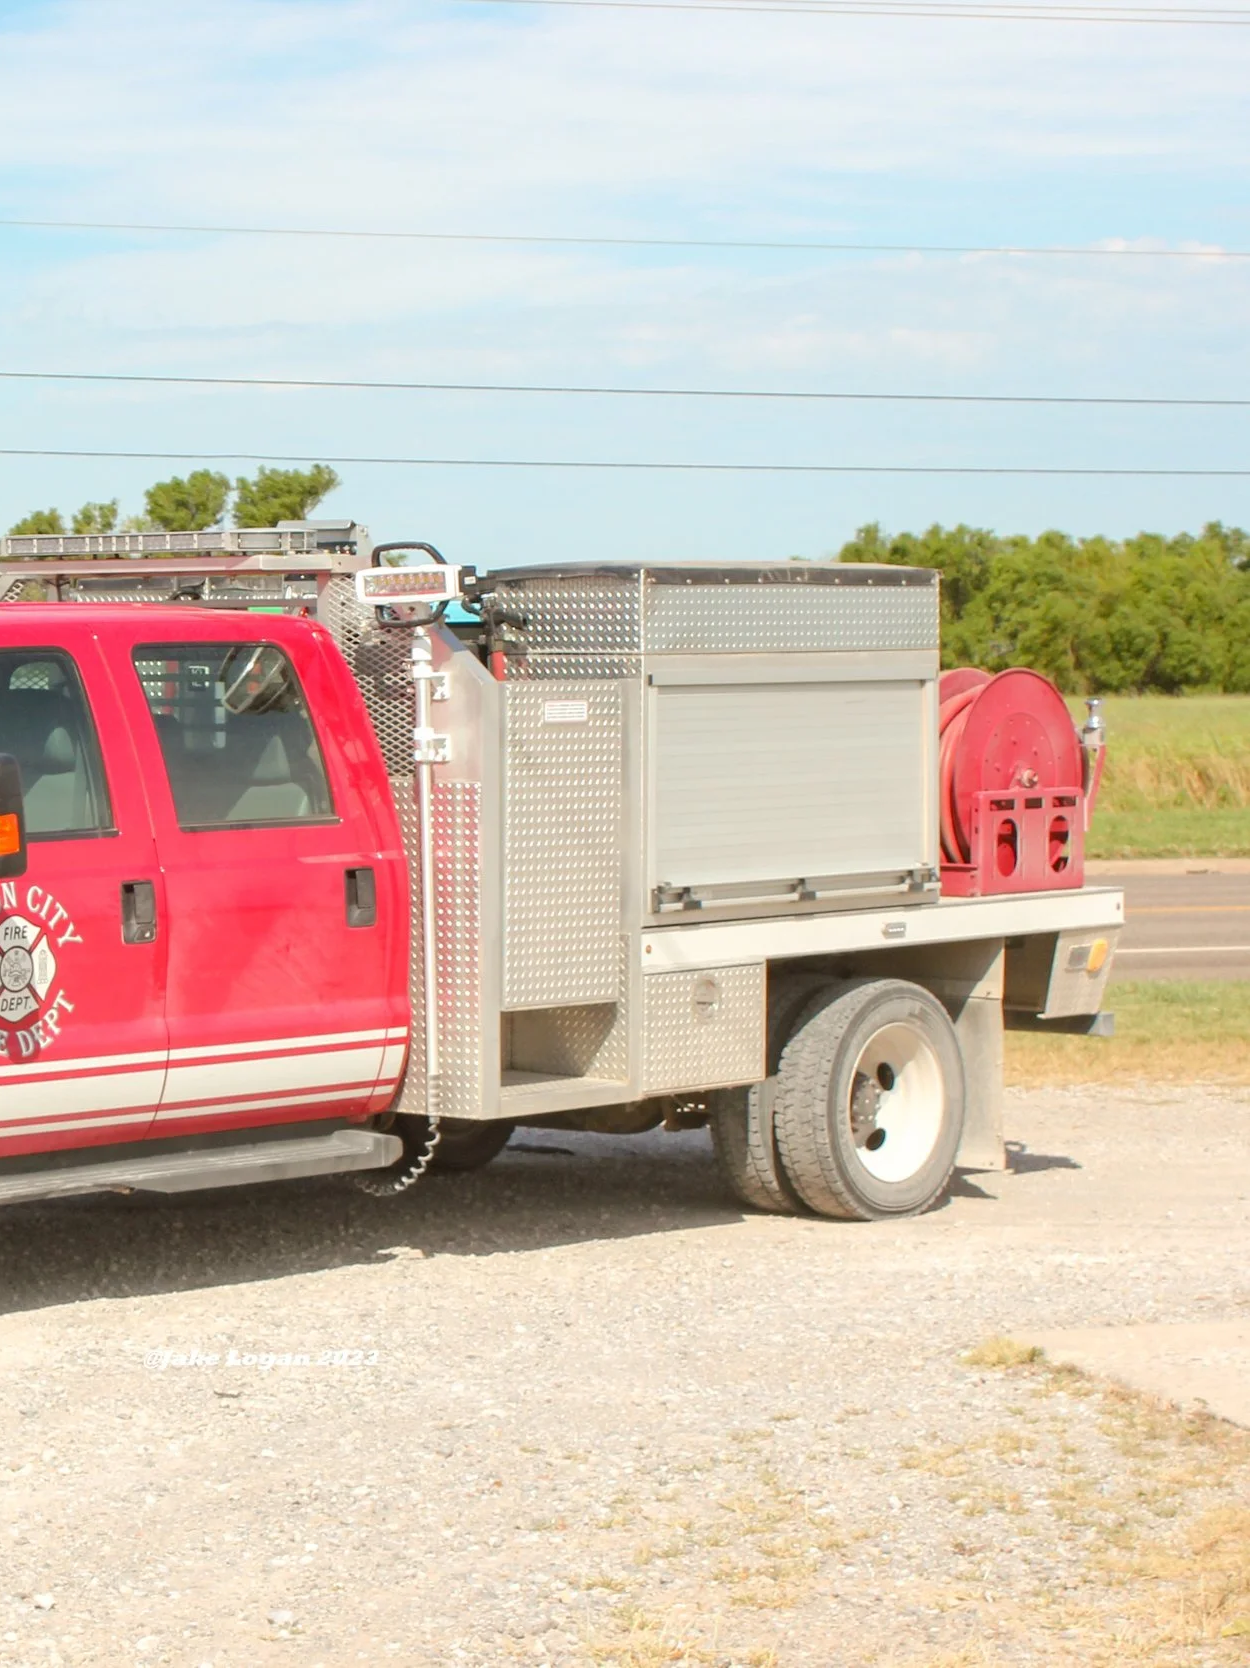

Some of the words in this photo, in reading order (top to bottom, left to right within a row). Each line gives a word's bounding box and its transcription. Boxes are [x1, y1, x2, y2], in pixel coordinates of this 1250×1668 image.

[3, 925, 28, 941] FIRE
[26, 885, 84, 948] CITY
[16, 989, 75, 1057] DEPT
